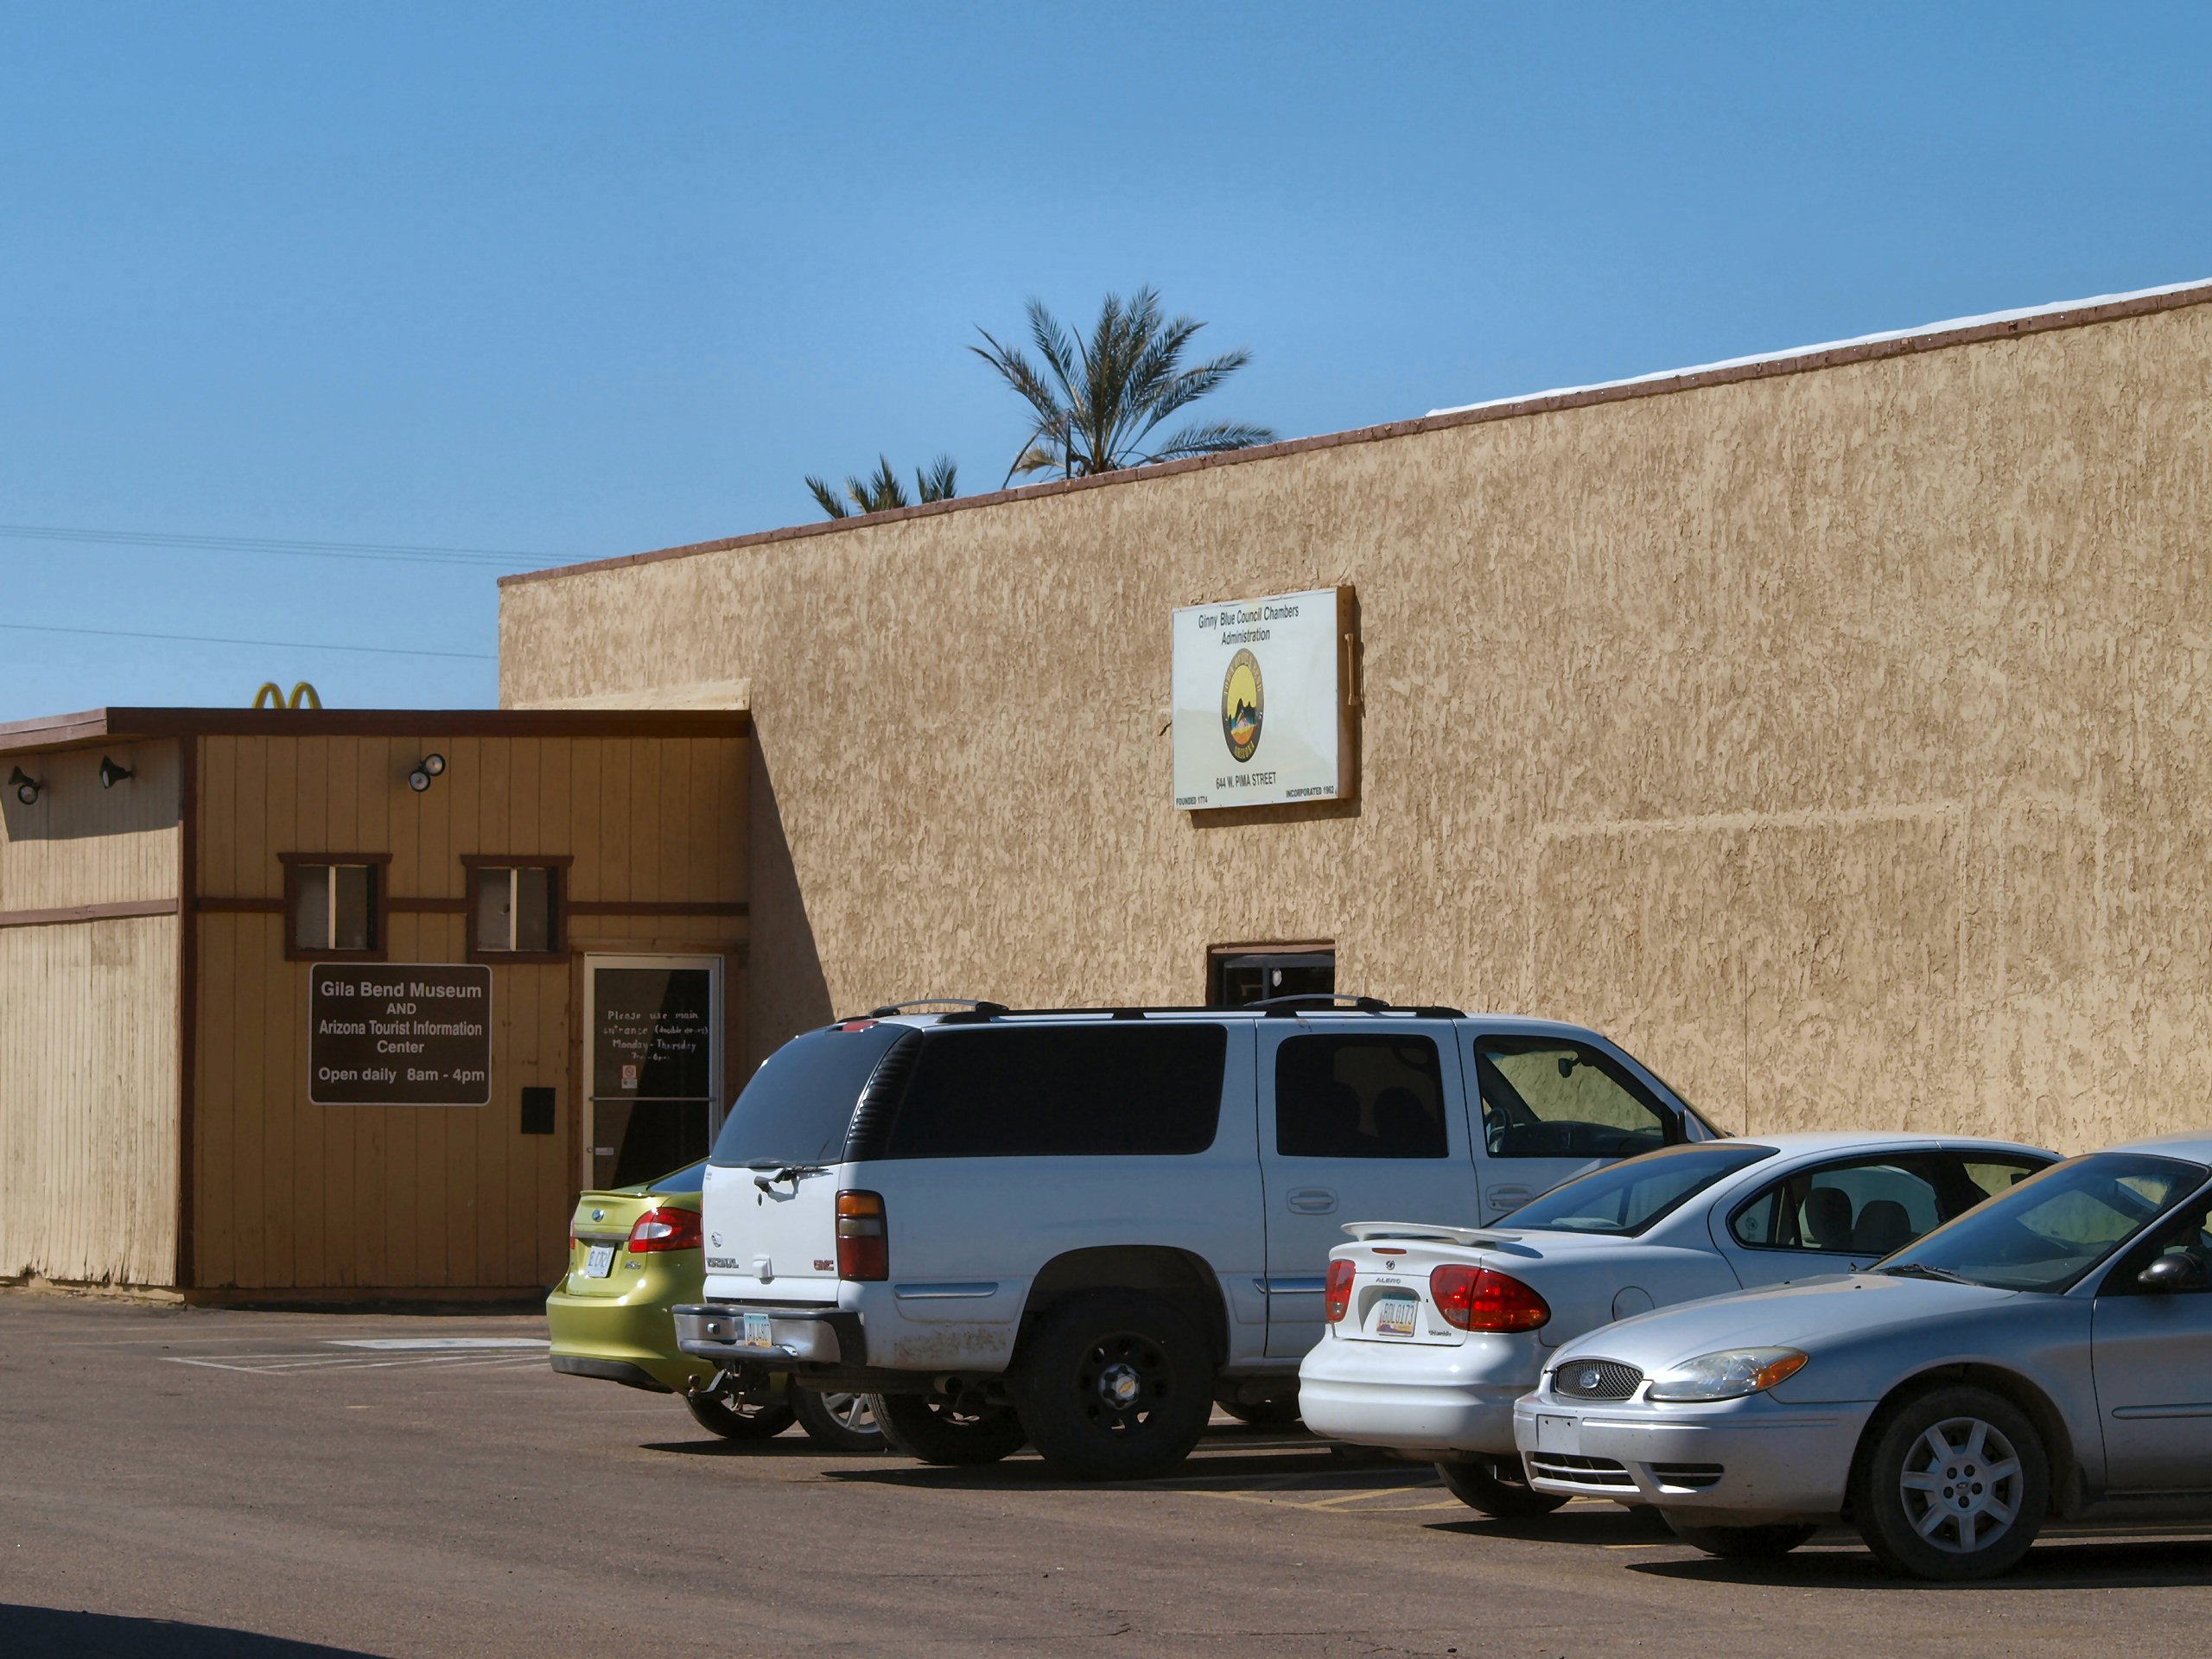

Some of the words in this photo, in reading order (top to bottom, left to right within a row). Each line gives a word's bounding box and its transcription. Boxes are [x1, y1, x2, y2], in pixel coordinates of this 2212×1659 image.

[1198, 614, 1217, 630] Ginny
[1220, 612, 1235, 626] Blue
[1236, 607, 1262, 624] Council
[1263, 605, 1300, 620] Chambers
[1221, 626, 1270, 645] Administration
[1216, 778, 1226, 790] 644
[1227, 776, 1234, 788] W.
[1236, 774, 1250, 787] PIMA
[1252, 772, 1276, 786] STREET
[1286, 786, 1322, 798] INCORPORATED
[1176, 797, 1197, 806] FOUNDED
[321, 981, 354, 996] Gila
[360, 982, 404, 997] Bend
[410, 982, 482, 998] Museum
[386, 1002, 416, 1014] AND
[607, 1010, 640, 1020] Please
[675, 1009, 699, 1019] main
[319, 1020, 365, 1035] Arizona
[369, 1020, 410, 1035] Tourist
[413, 1020, 482, 1036] Information
[377, 1039, 425, 1053] Center
[318, 1067, 358, 1084] Open
[362, 1068, 397, 1084] daily
[407, 1068, 439, 1081] 8am
[453, 1069, 485, 1084] 4pm
